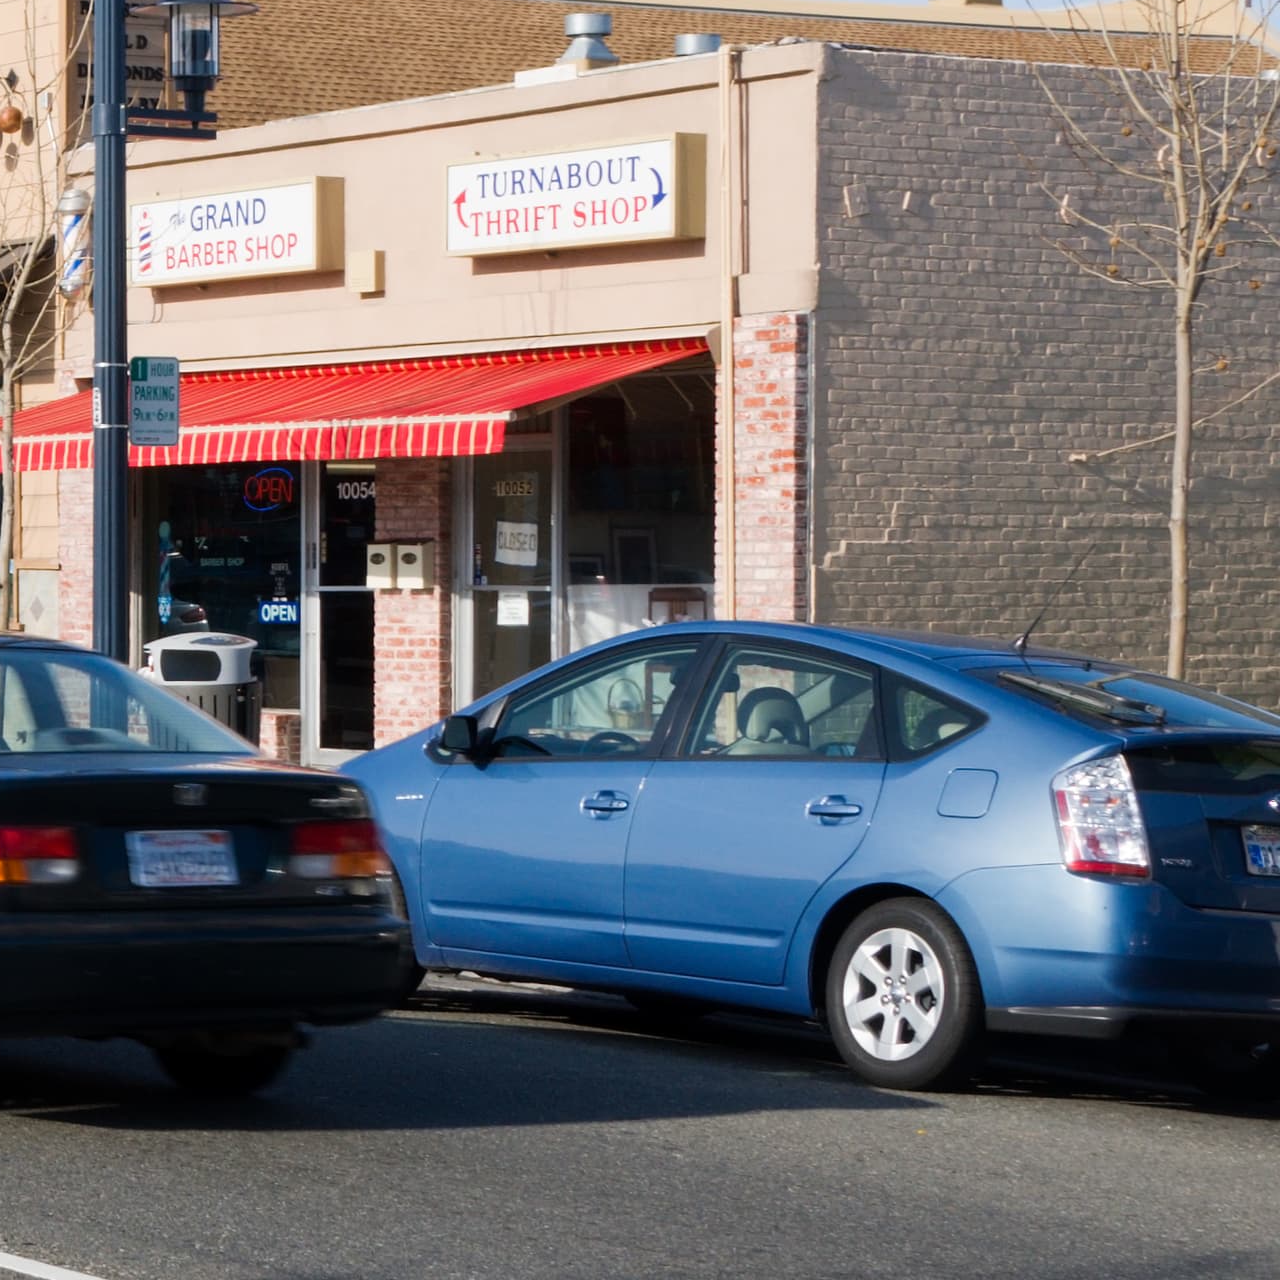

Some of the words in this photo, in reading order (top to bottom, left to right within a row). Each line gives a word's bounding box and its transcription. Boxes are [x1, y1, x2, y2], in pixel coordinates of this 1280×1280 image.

[477, 156, 641, 199] TURNABOUT
[190, 198, 266, 232] GRAND
[470, 204, 561, 237] THRIFT
[573, 195, 647, 228] SHOP
[165, 240, 238, 270] BARBER
[245, 233, 298, 262] SHOP
[151, 363, 175, 377] HOUR
[134, 386, 175, 401] PARKING
[244, 476, 293, 503] OPEN
[336, 482, 377, 499] 10054
[497, 481, 534, 496] 10052
[497, 531, 538, 552] CLOSED
[261, 604, 297, 623] OPEN
